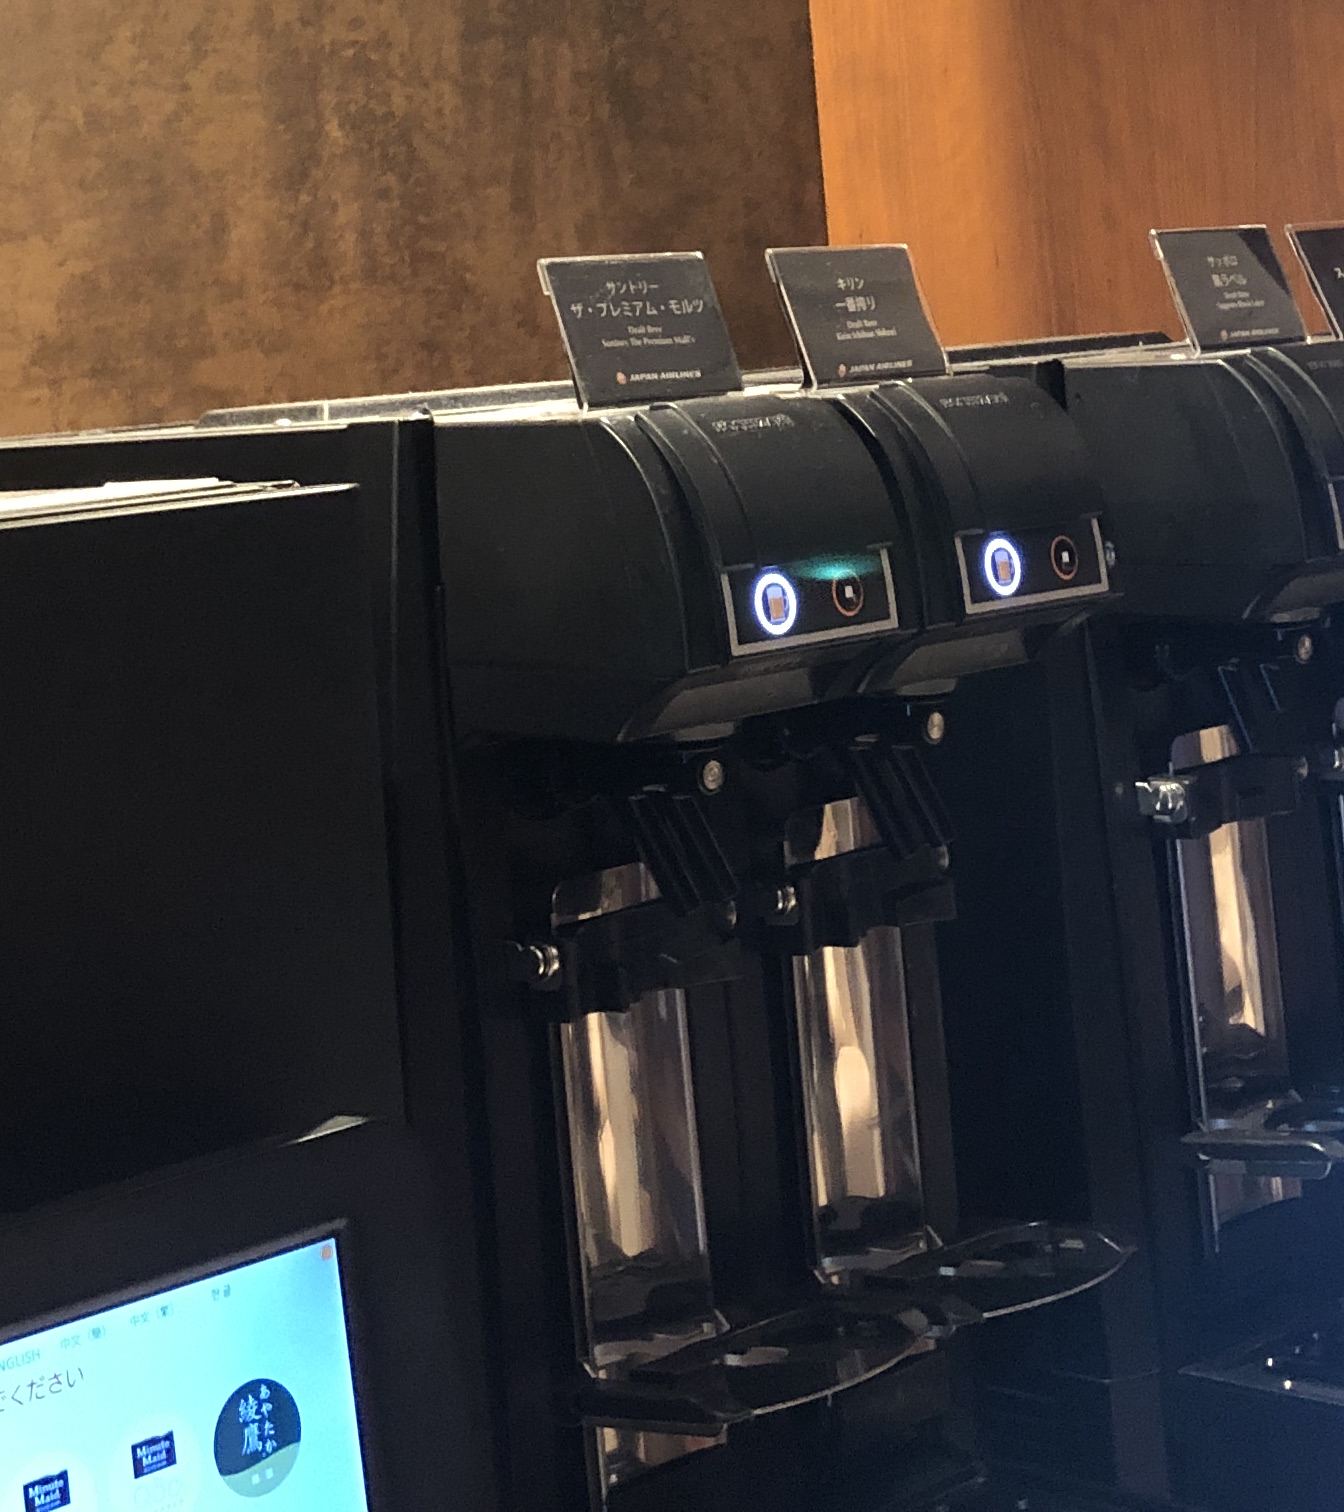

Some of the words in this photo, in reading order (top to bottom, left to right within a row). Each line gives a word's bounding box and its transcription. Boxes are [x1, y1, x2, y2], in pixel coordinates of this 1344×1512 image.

[606, 280, 660, 296] サントリー
[836, 277, 865, 290] キリン
[570, 299, 704, 319] ザ・プレミアム・モルツ
[630, 372, 659, 381] JAPAN
[660, 370, 702, 379] AIRLINES
[136, 1440, 170, 1459] Minute
[142, 1449, 167, 1467] Maid
[28, 1479, 64, 1499] Minute
[34, 1488, 61, 1507] Maid
